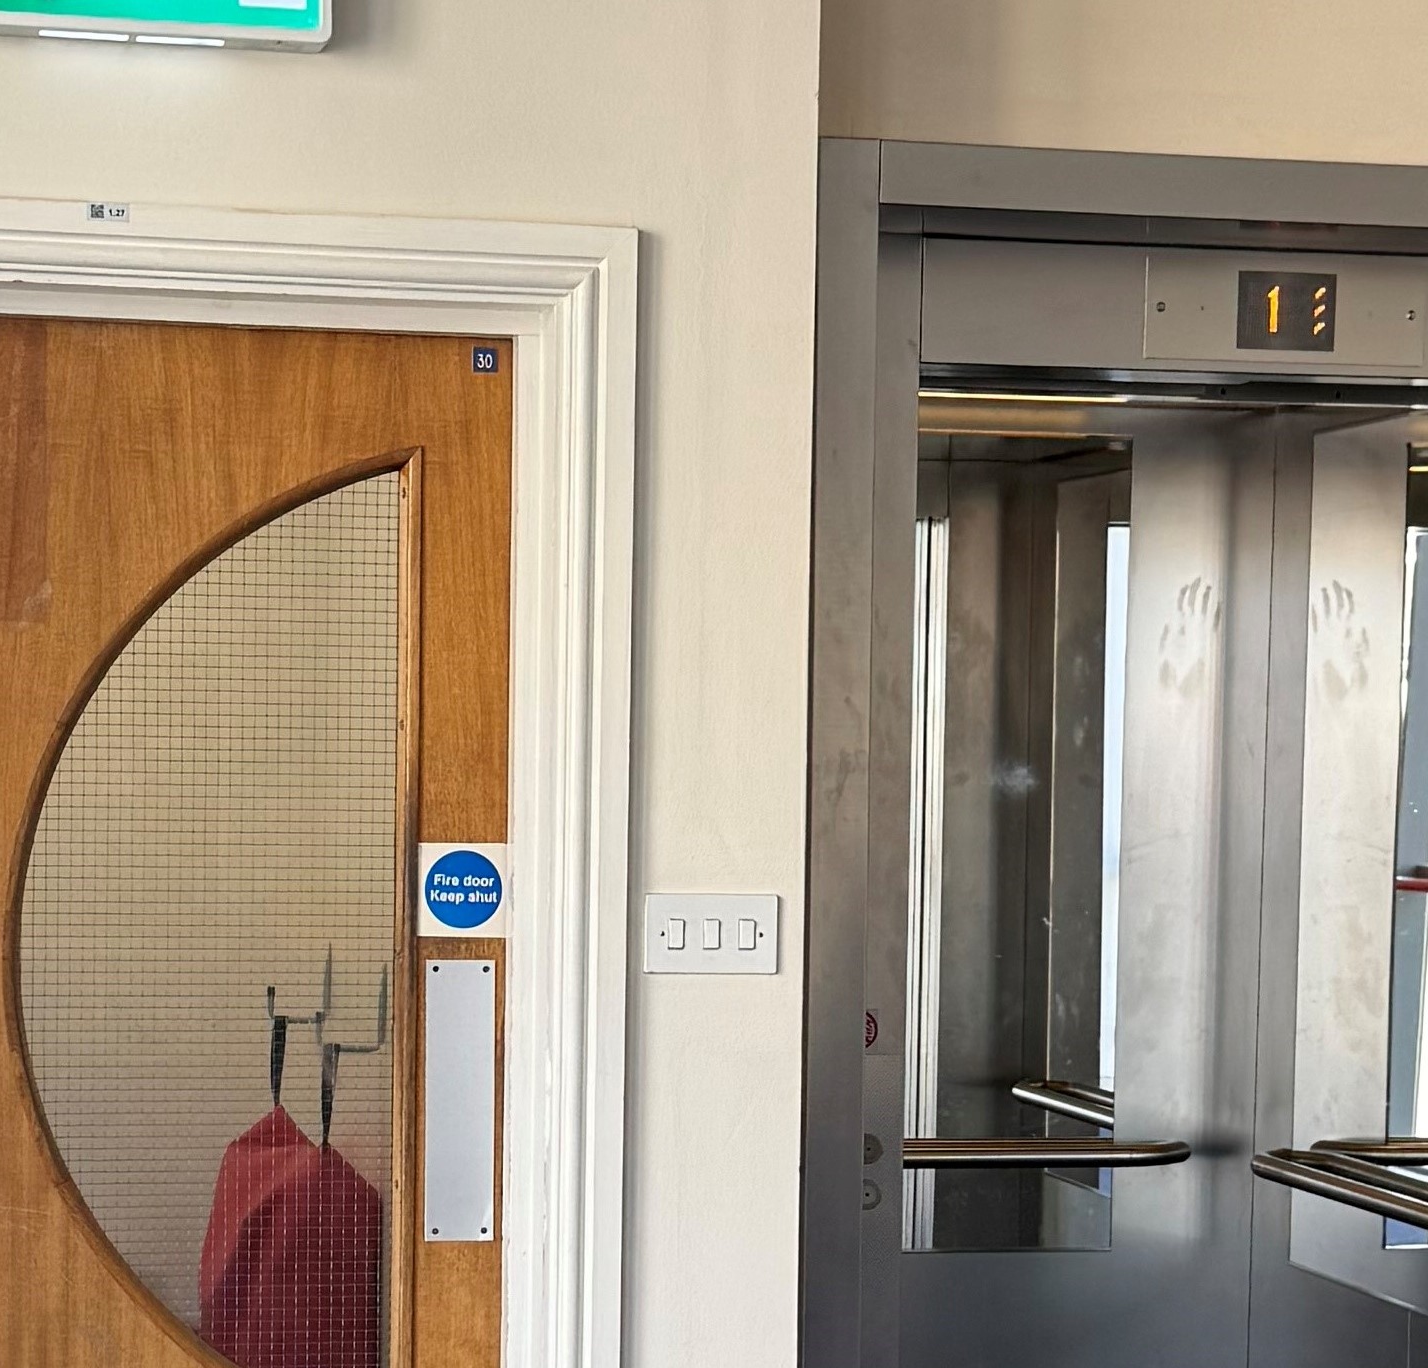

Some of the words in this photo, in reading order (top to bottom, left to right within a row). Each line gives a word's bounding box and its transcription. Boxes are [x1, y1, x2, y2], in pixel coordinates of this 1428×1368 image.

[1267, 285, 1280, 334] 1
[477, 353, 493, 369] 30
[433, 873, 459, 887] Fire
[463, 875, 495, 887] door
[430, 890, 465, 905] Keep
[467, 890, 498, 903] shut
